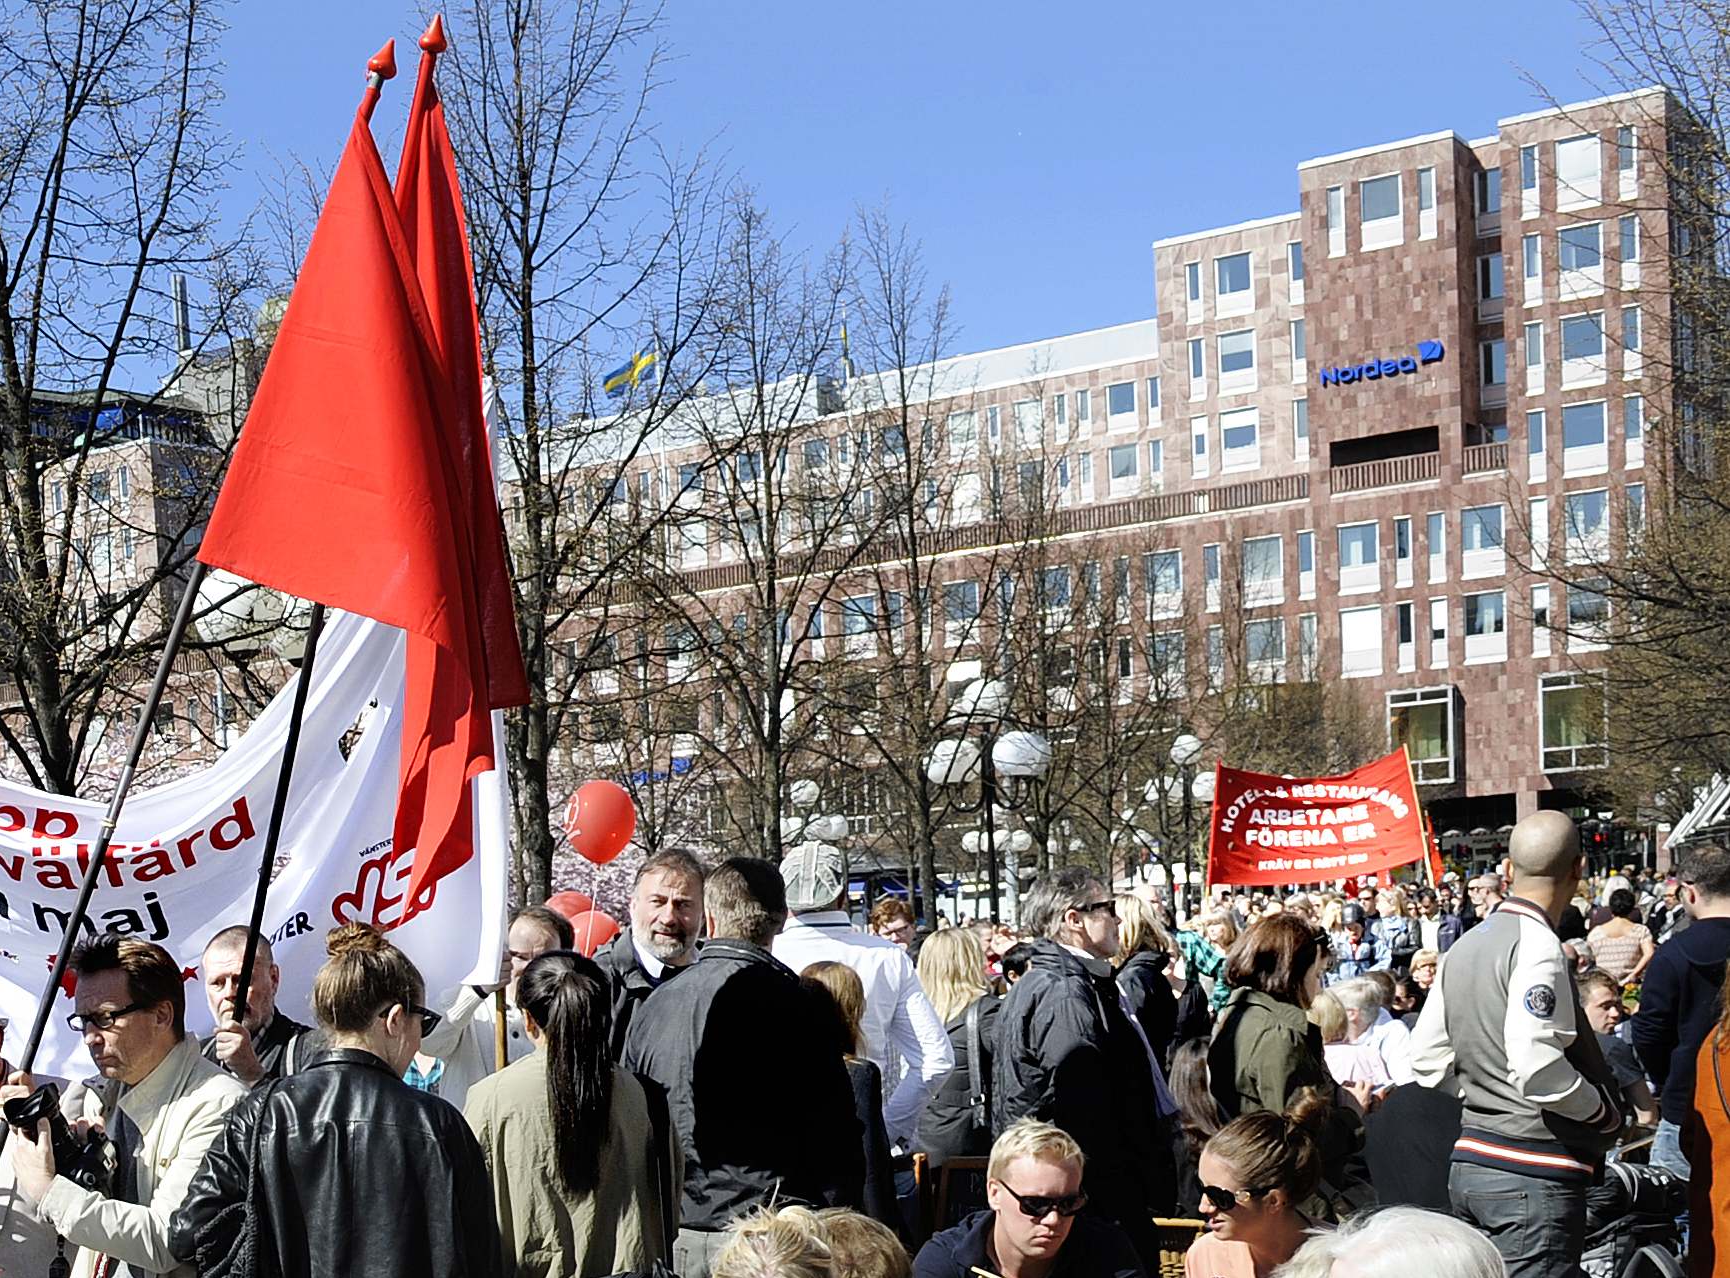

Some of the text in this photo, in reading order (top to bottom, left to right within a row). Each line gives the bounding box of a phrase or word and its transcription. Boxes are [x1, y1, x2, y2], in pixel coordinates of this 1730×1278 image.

[1320, 356, 1416, 387] Nordea
[1248, 804, 1370, 826] ARBETARE
[1276, 785, 1289, 799] &
[1291, 784, 1409, 819] RESTAURANG
[1245, 822, 1377, 847] FÖRENA ER
[33, 892, 169, 941] maj
